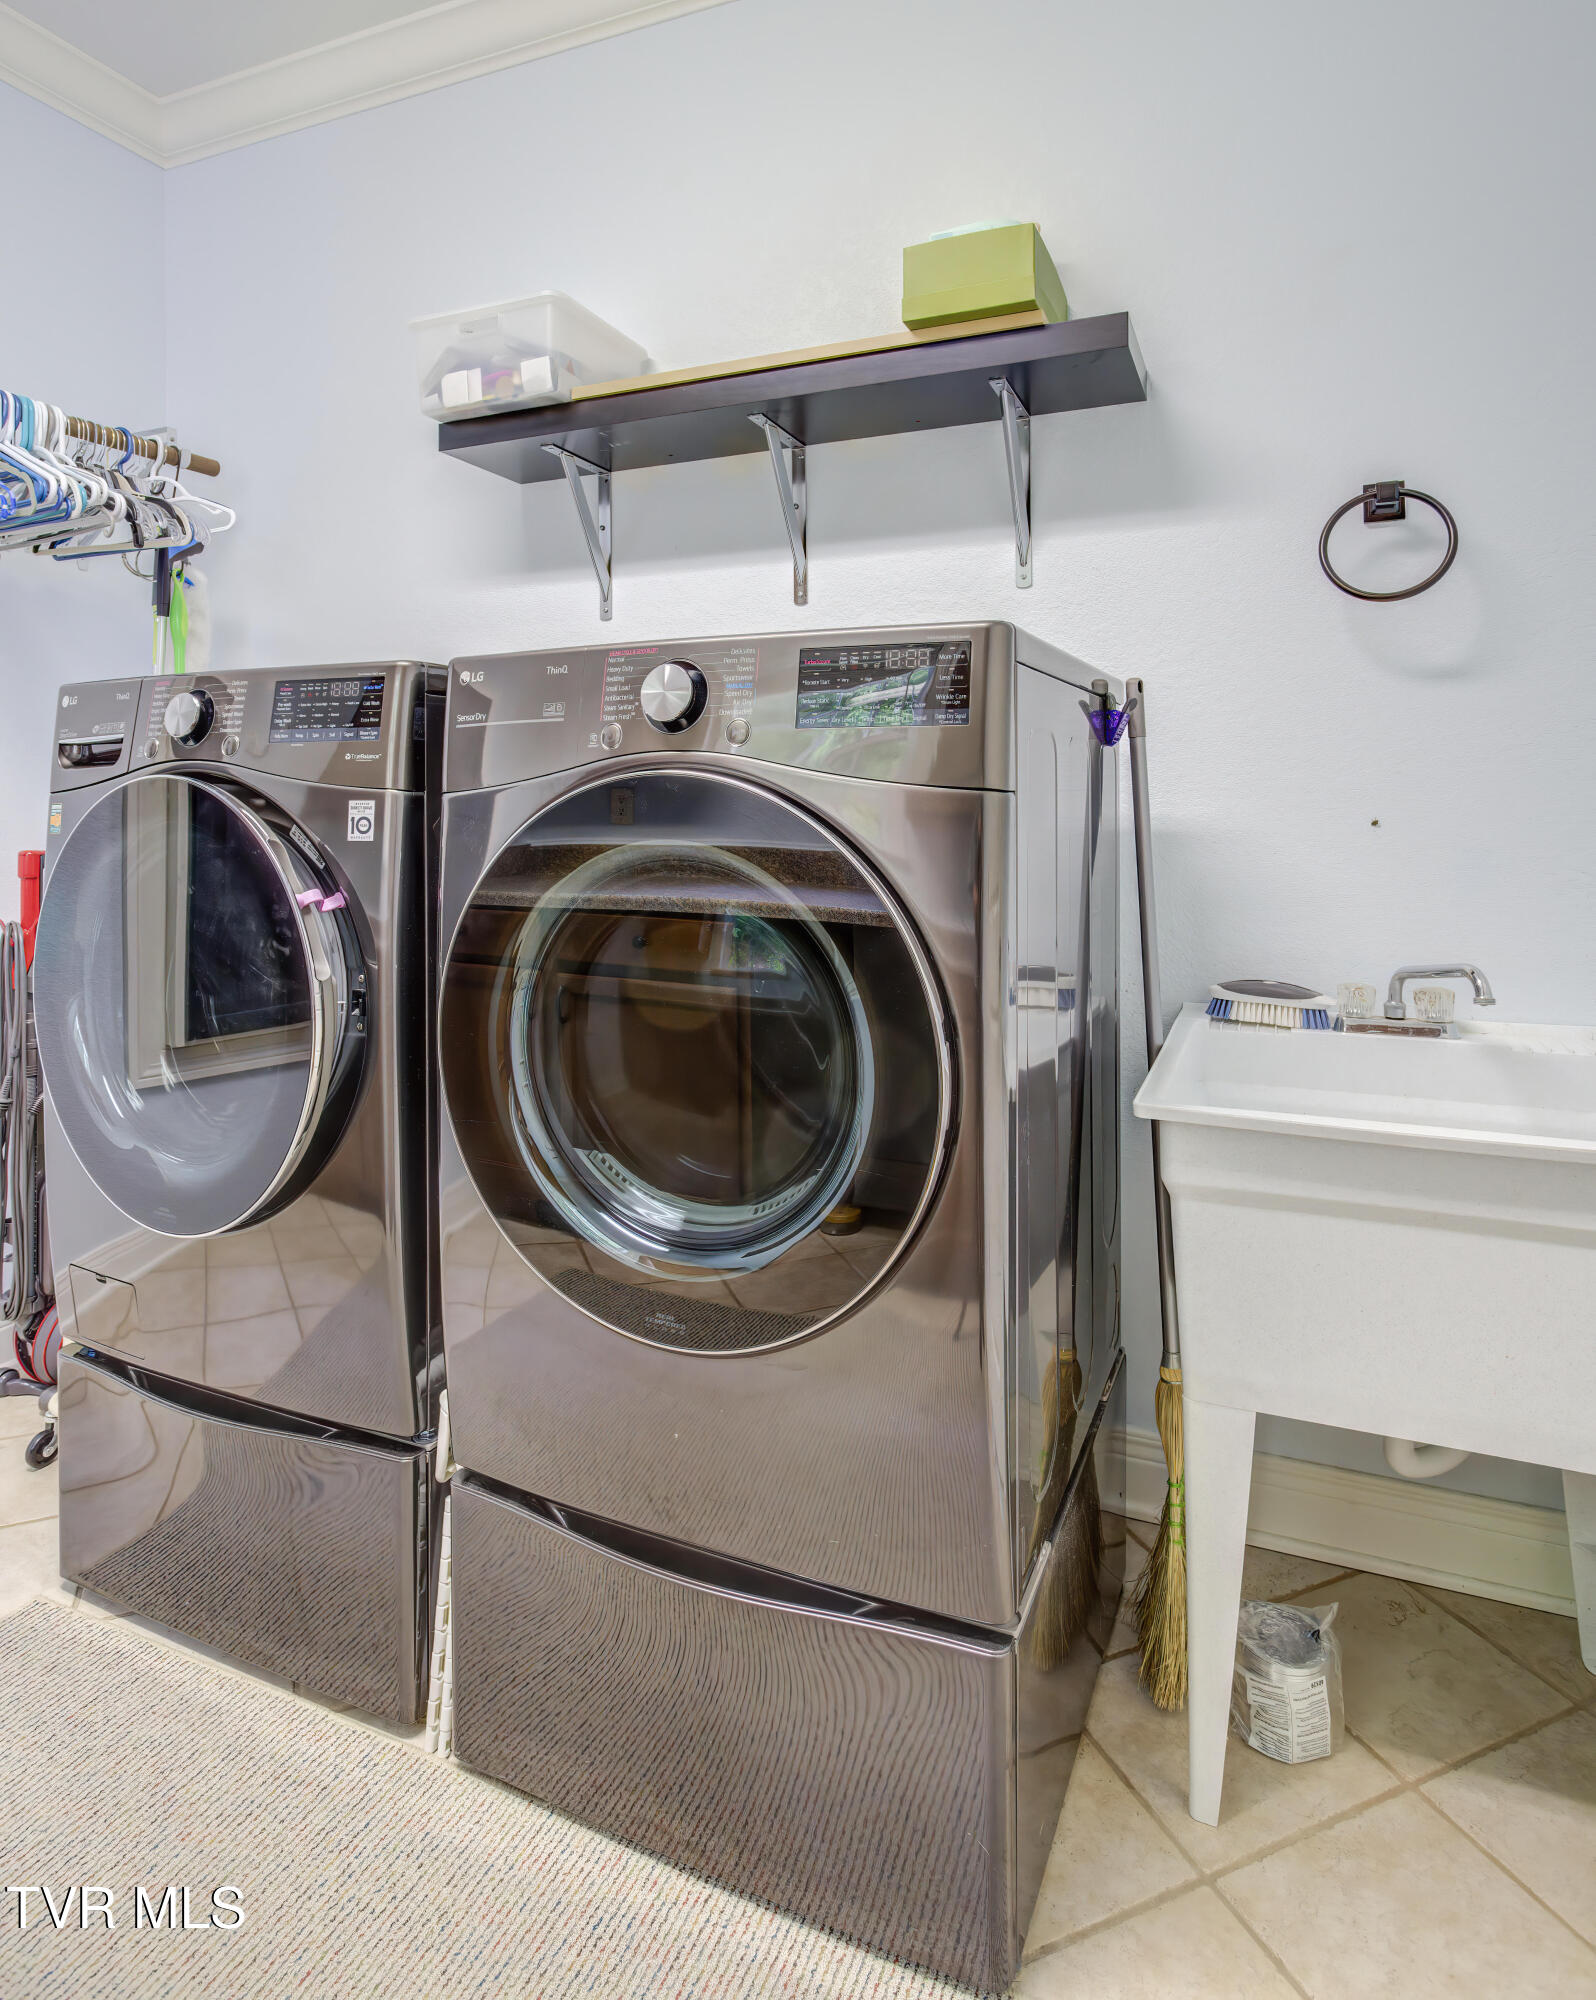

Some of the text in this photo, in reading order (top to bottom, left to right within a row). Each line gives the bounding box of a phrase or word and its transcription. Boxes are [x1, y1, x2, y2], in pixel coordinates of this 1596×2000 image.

[546, 665, 568, 675] ThinQ
[471, 672, 484, 682] LG
[69, 696, 78, 705] LG
[116, 692, 130, 700] ThinQ
[351, 816, 372, 834] 10
